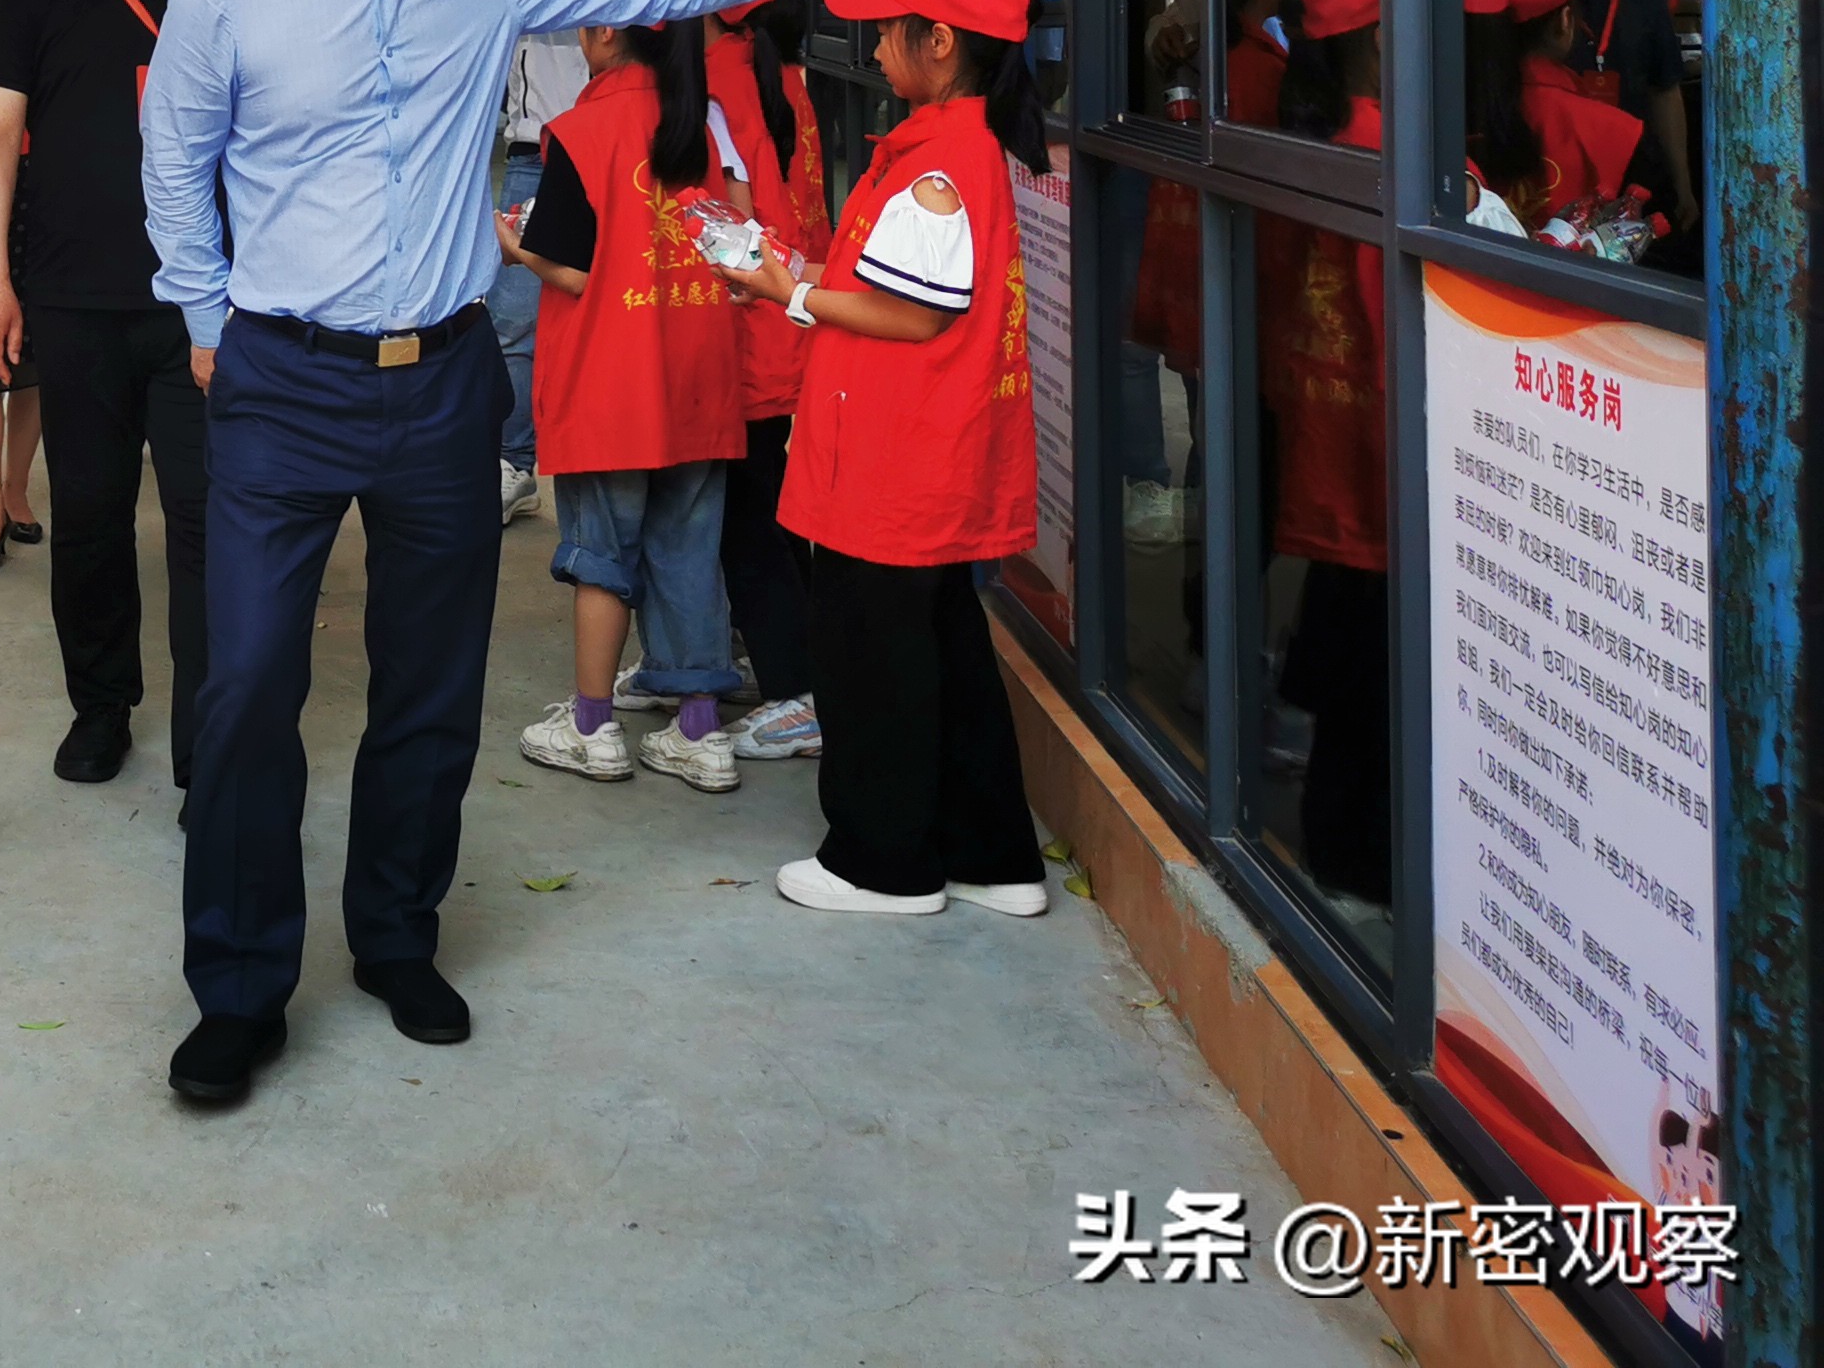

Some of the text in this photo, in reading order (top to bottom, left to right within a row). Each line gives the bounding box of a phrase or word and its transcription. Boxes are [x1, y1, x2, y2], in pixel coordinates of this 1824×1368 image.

[1514, 346, 1622, 432] 知心服务岗
